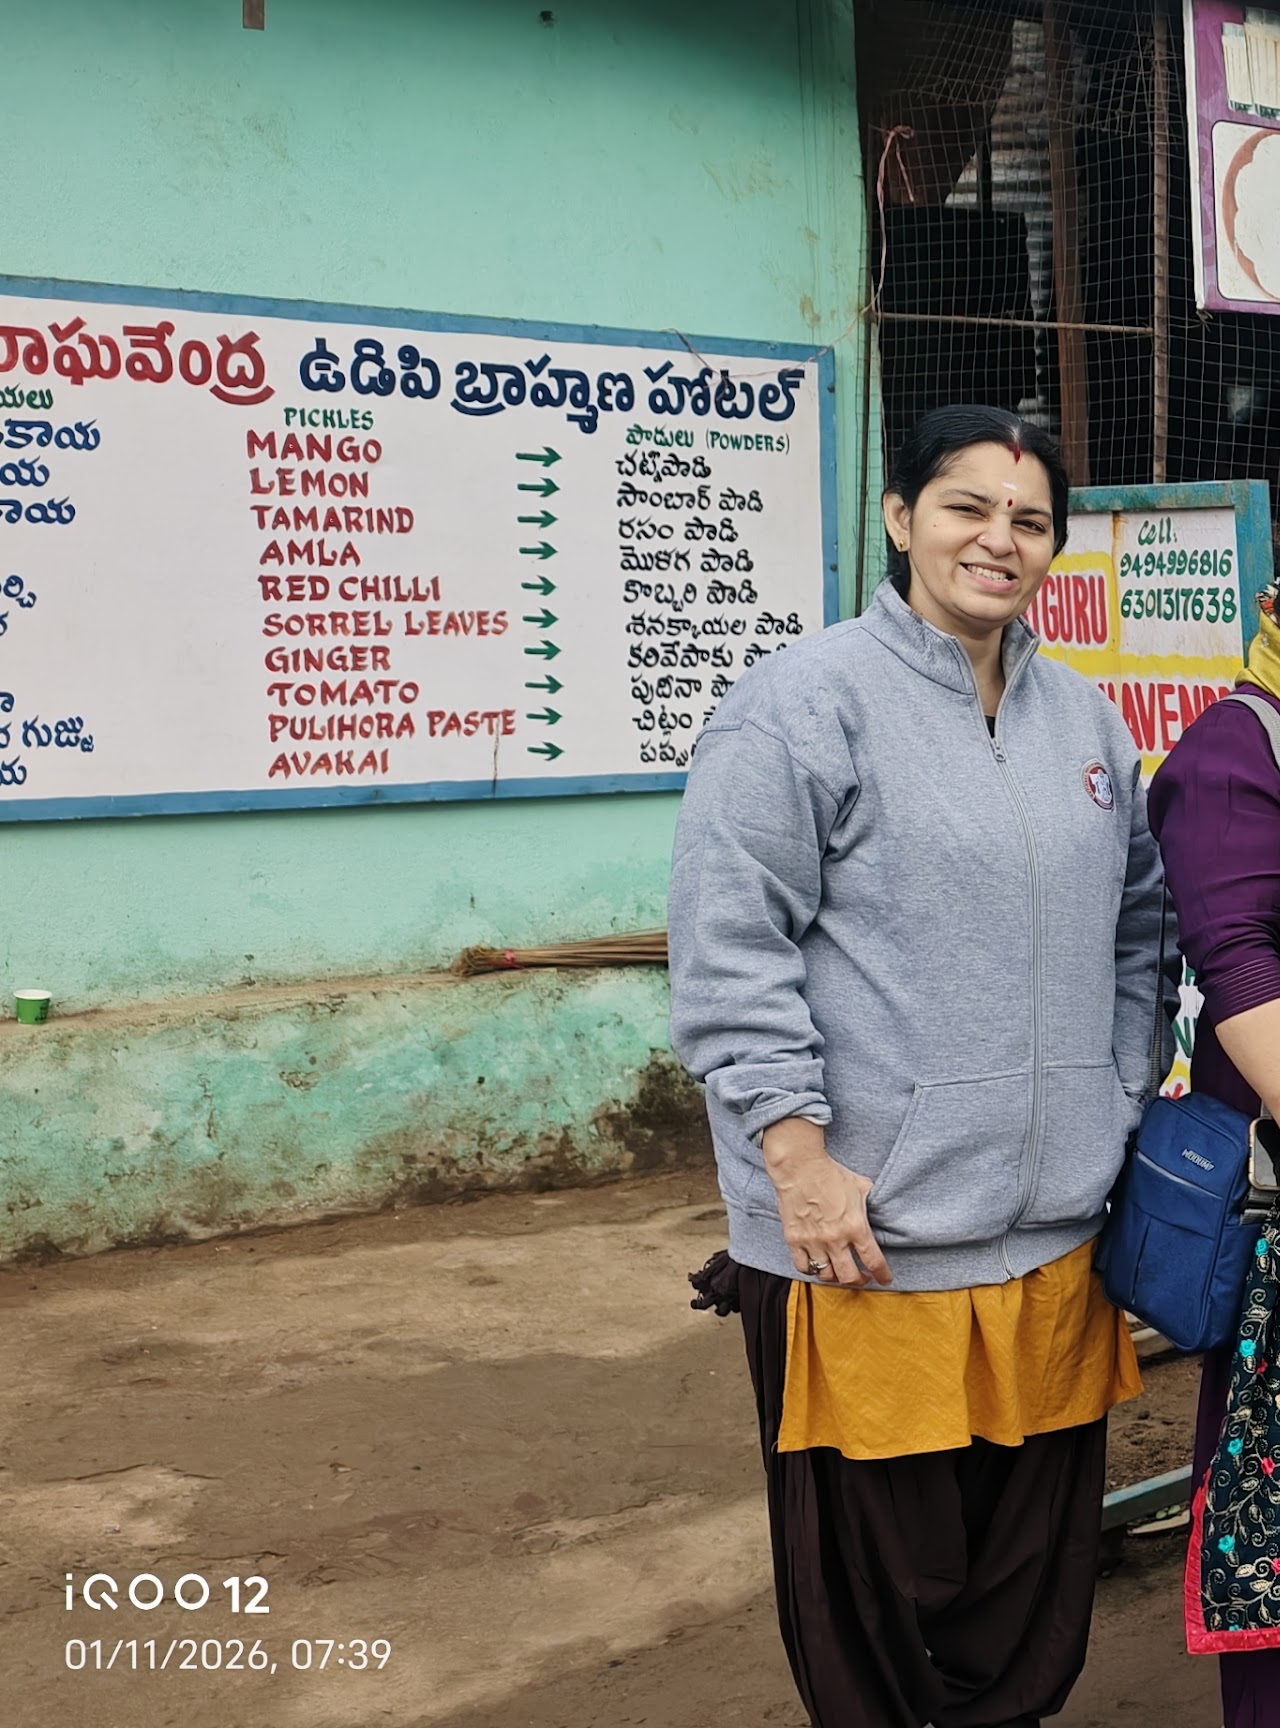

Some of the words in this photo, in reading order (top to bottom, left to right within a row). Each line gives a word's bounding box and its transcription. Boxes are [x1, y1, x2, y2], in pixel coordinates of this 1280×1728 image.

[299, 337, 441, 399] ఉడిపి
[450, 353, 635, 434] బ్రాహ్మణ
[643, 360, 805, 421] హోటల్
[284, 407, 374, 431] PICKLES
[247, 429, 383, 464] MANGO
[706, 428, 790, 454] (POWDERS)
[249, 467, 369, 498] LEMON
[250, 505, 415, 534] TAMARIND
[618, 516, 674, 540] రసం
[259, 538, 362, 568] AMLA
[1120, 548, 1234, 578] 9494996816
[257, 575, 330, 602] RED
[338, 575, 441, 602] CHILLI
[1120, 587, 1238, 624] 6301317638
[262, 610, 393, 637] SORREL
[404, 609, 509, 637] LEAVES
[264, 644, 391, 674] GINGER
[266, 679, 420, 707] TOMATO
[268, 711, 415, 743] PULIHORA
[427, 708, 516, 738] PASTE
[268, 748, 389, 780] AVAKAI
